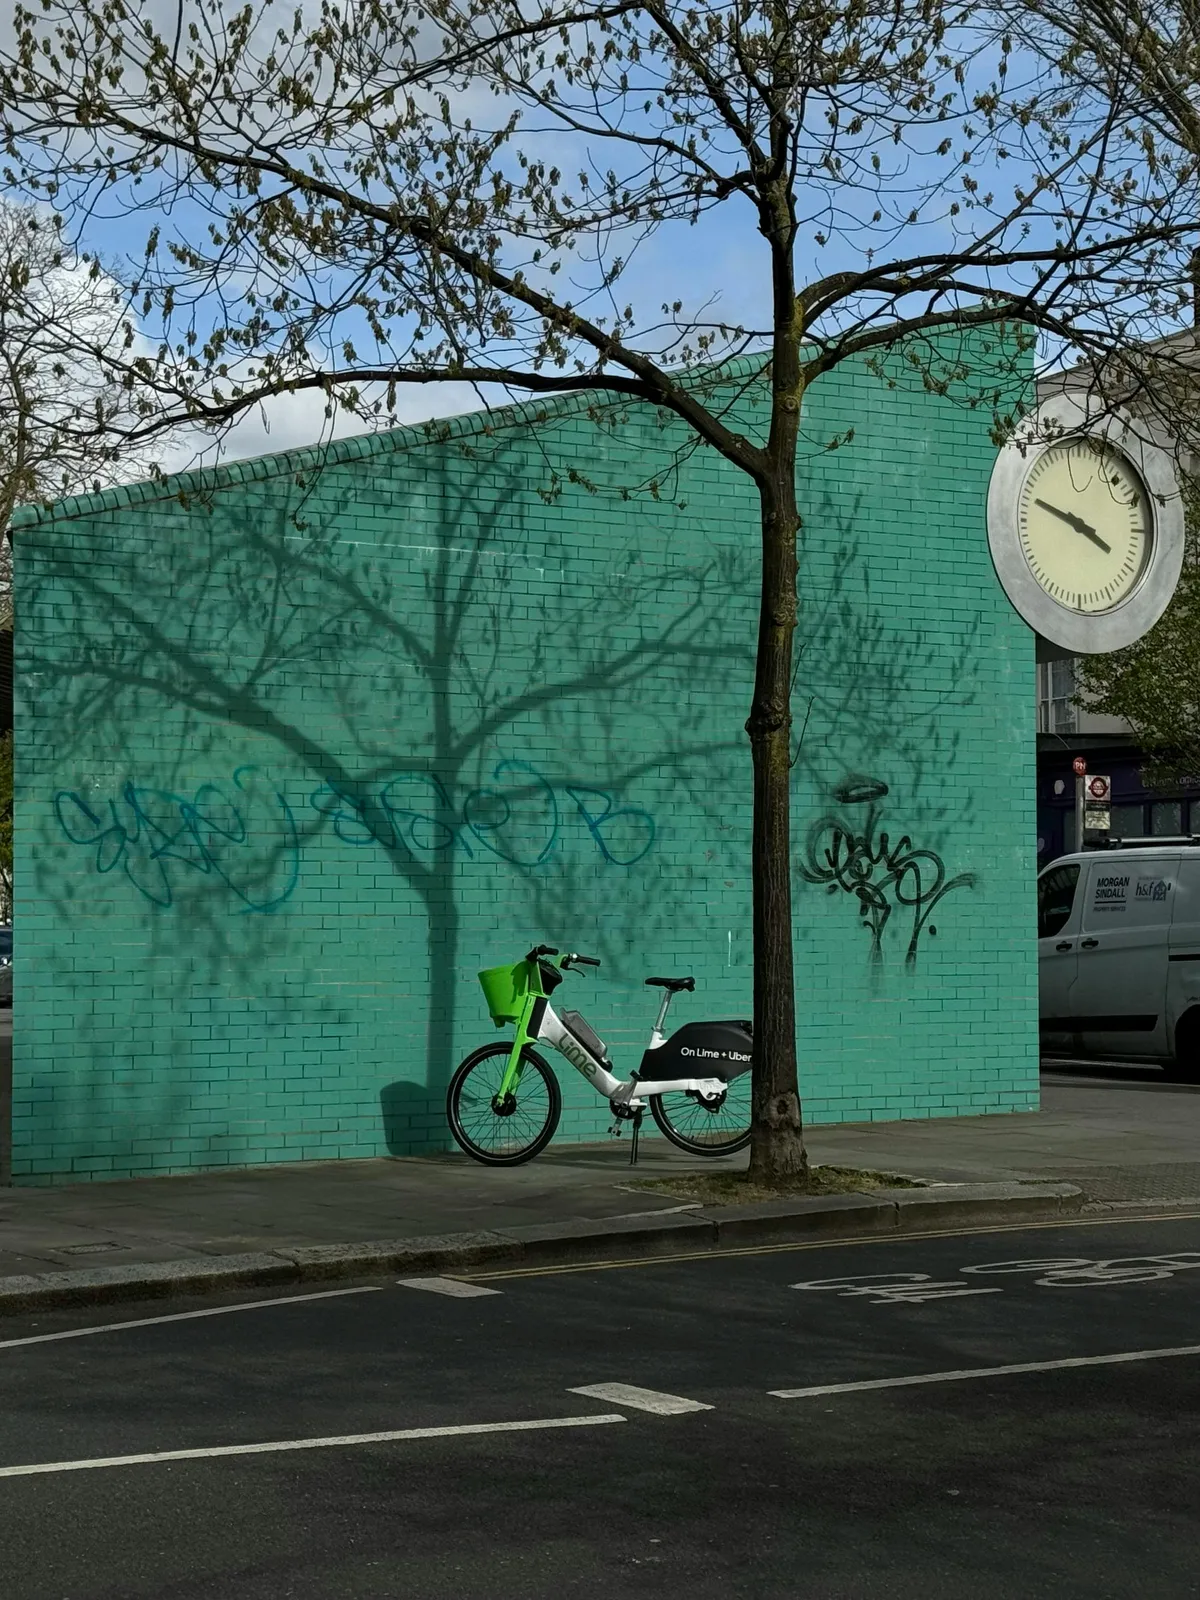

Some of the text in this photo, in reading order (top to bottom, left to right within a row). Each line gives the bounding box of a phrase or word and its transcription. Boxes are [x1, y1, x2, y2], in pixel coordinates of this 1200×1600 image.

[1097, 876, 1130, 887] MORGAN
[1095, 888, 1125, 898] SINDALL
[558, 1033, 597, 1077] Lime
[680, 1047, 695, 1057] On
[697, 1048, 720, 1059] Lime
[729, 1051, 752, 1062] Uber
